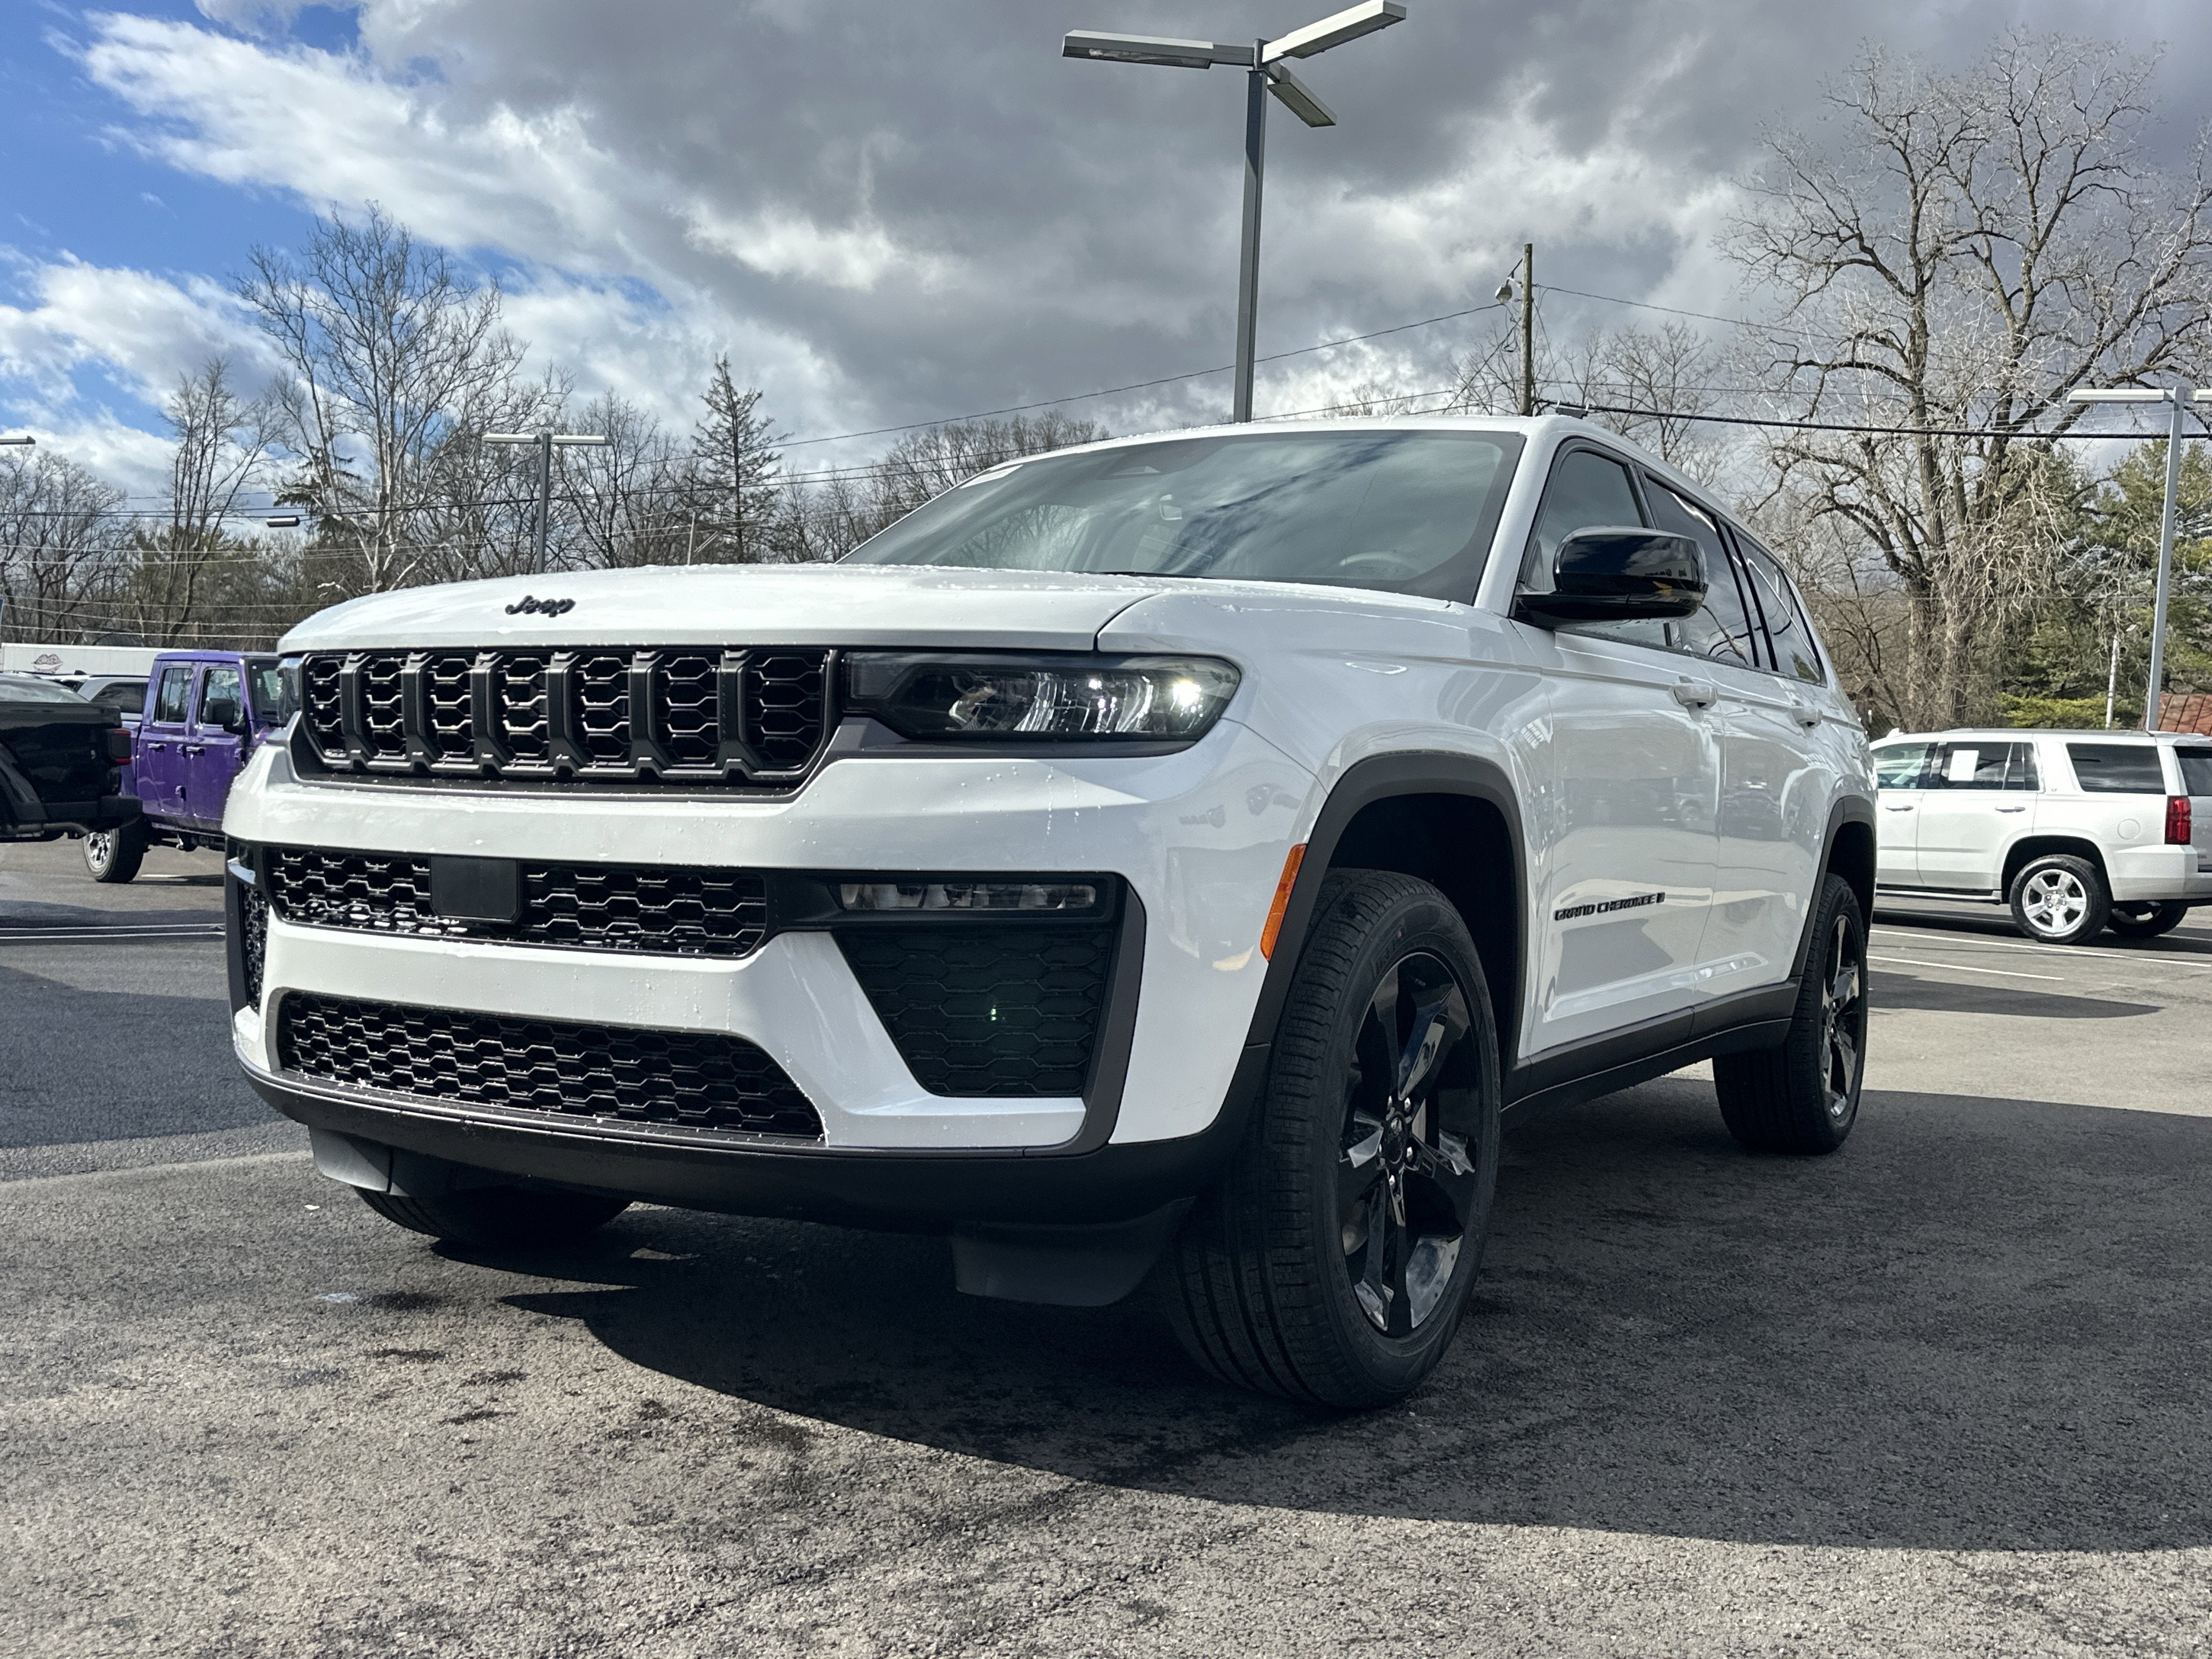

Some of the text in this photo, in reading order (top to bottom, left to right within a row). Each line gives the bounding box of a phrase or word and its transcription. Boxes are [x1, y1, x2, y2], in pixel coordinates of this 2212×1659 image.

[505, 595, 576, 618] Jeep
[1554, 904, 1595, 921] GRAND
[1597, 894, 1656, 913] CHEROKEE
